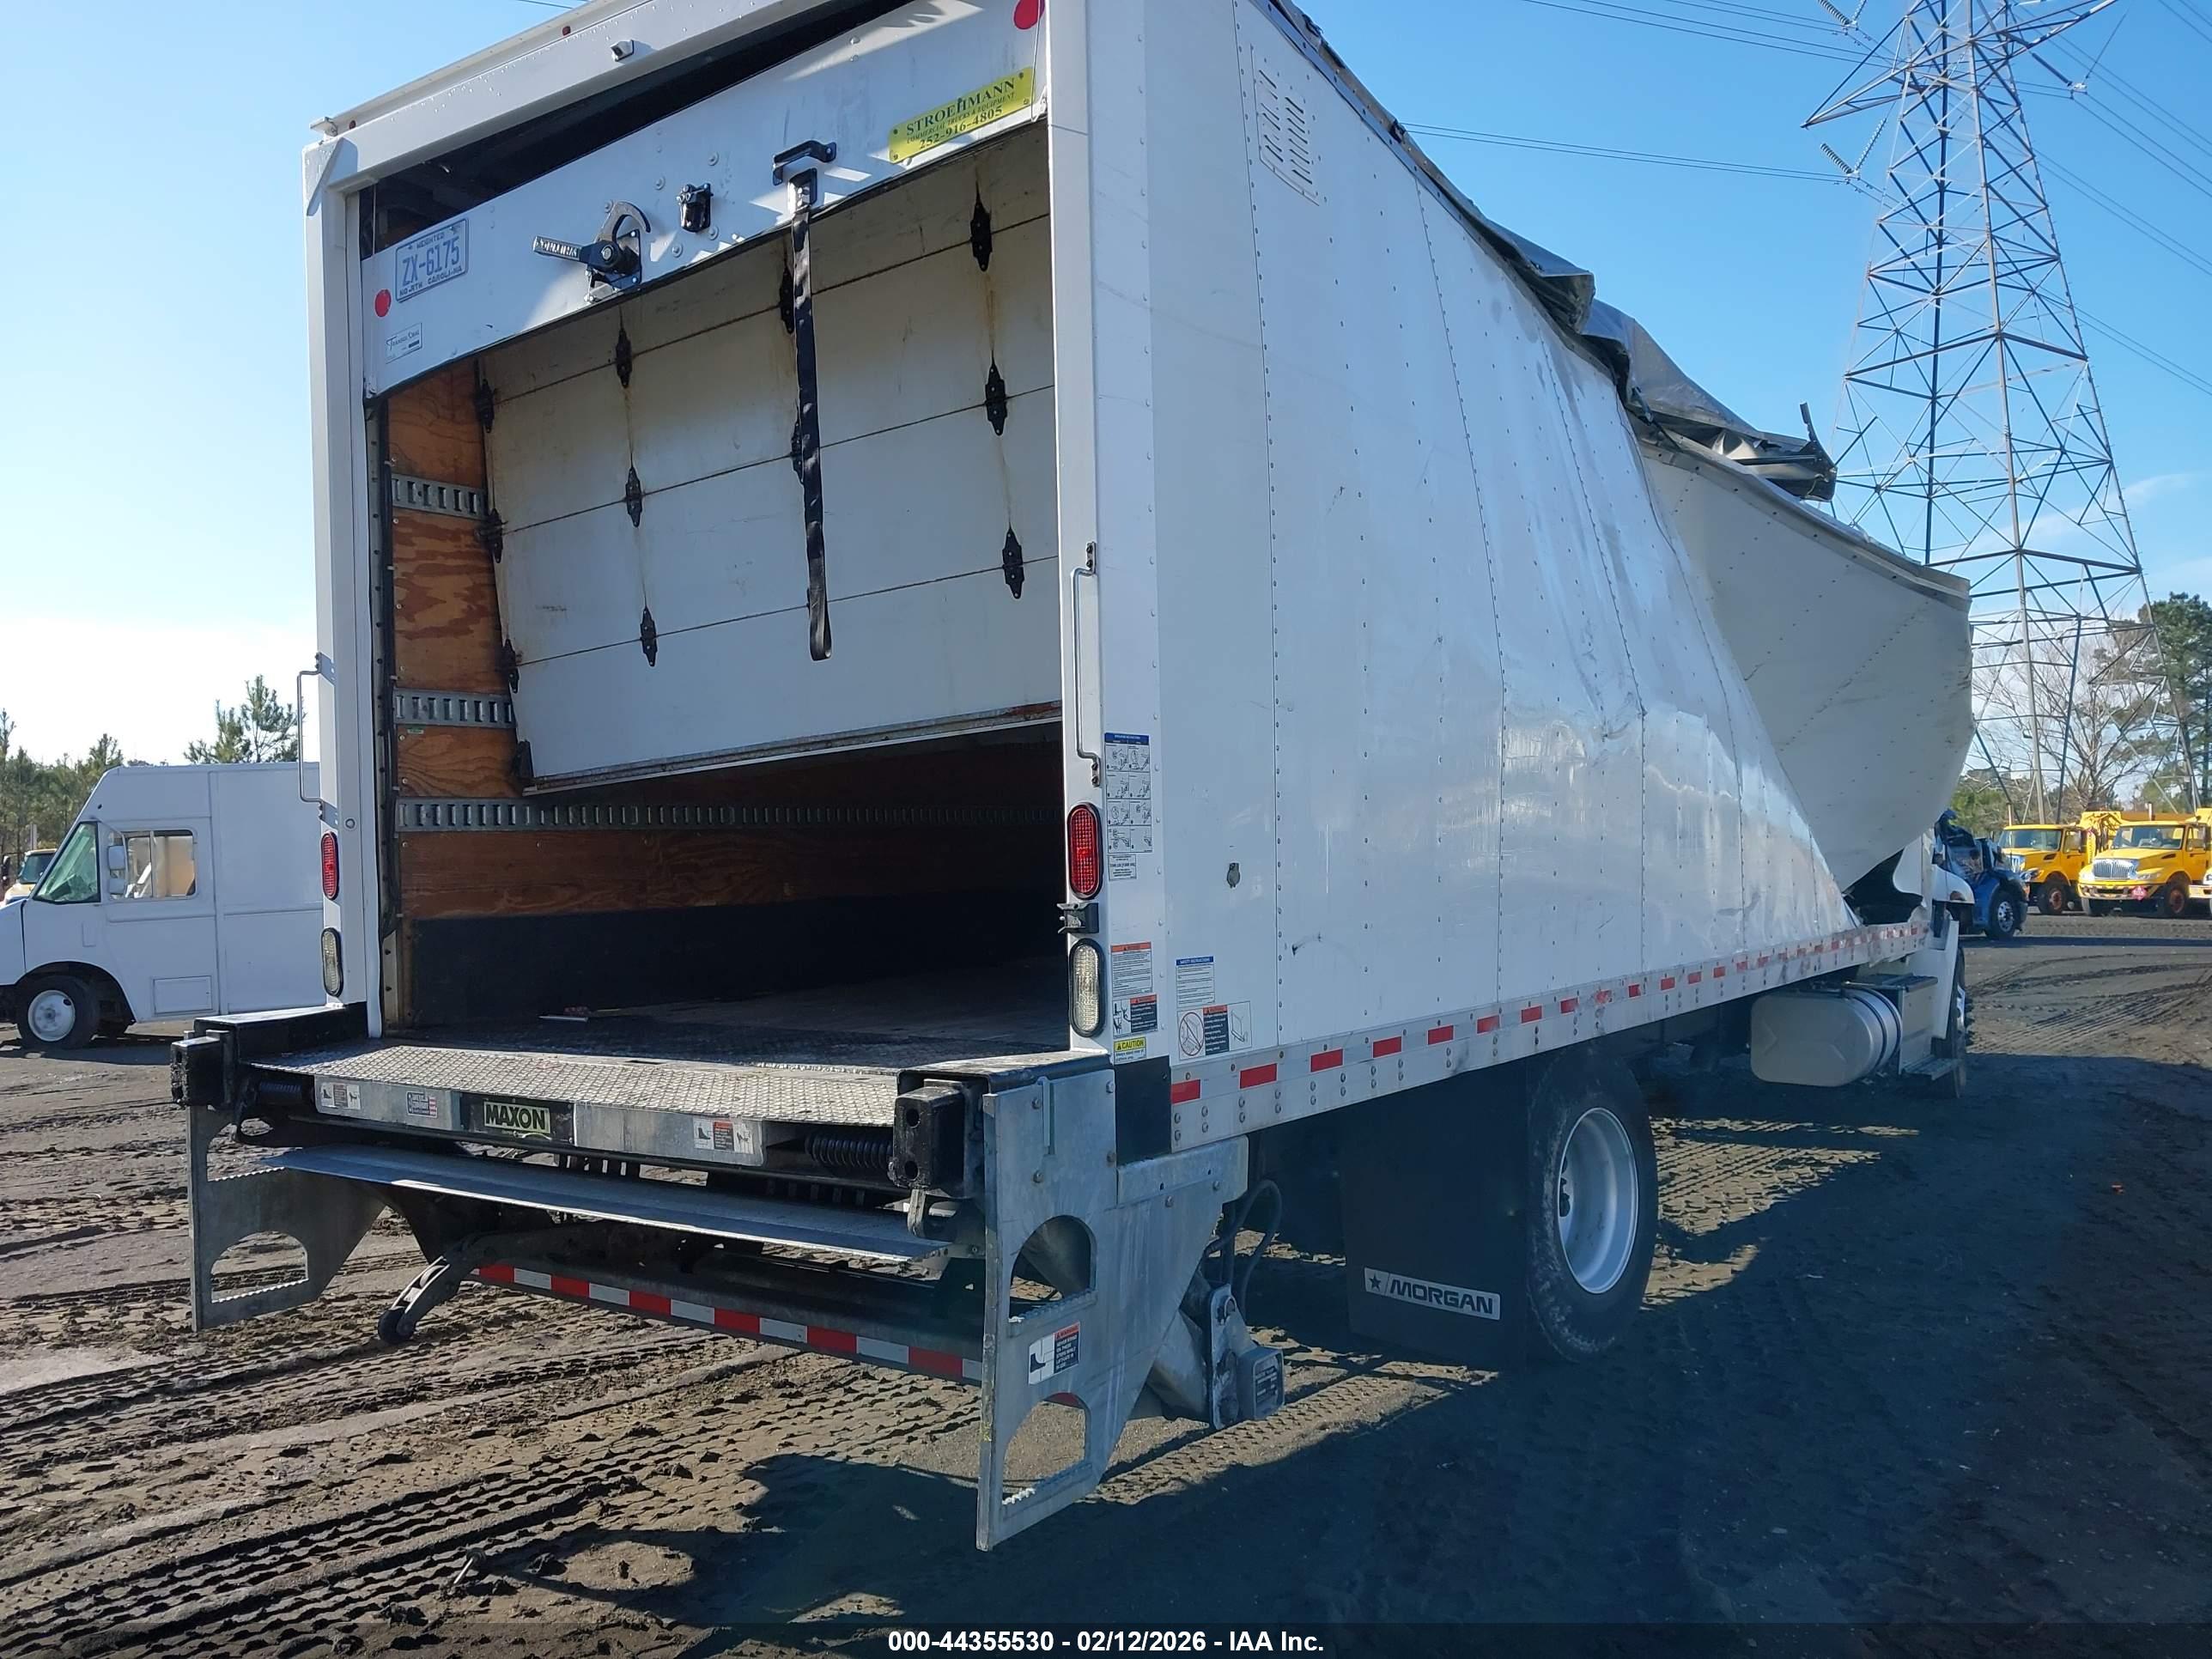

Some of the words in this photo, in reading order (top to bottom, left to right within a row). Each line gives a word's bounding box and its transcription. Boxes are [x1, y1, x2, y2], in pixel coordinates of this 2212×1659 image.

[907, 78, 1015, 136] STROEHMANN
[907, 123, 945, 143] COMMERCIAL
[977, 92, 1015, 112] EQUIPMENT
[920, 106, 1003, 149] 252-916-4805
[402, 235, 459, 287] ZX-6175
[399, 282, 422, 296] NORTH
[1122, 1040, 1144, 1049] CAUTION
[486, 1104, 546, 1129] MAXON
[1390, 1279, 1493, 1314] MORGAN
